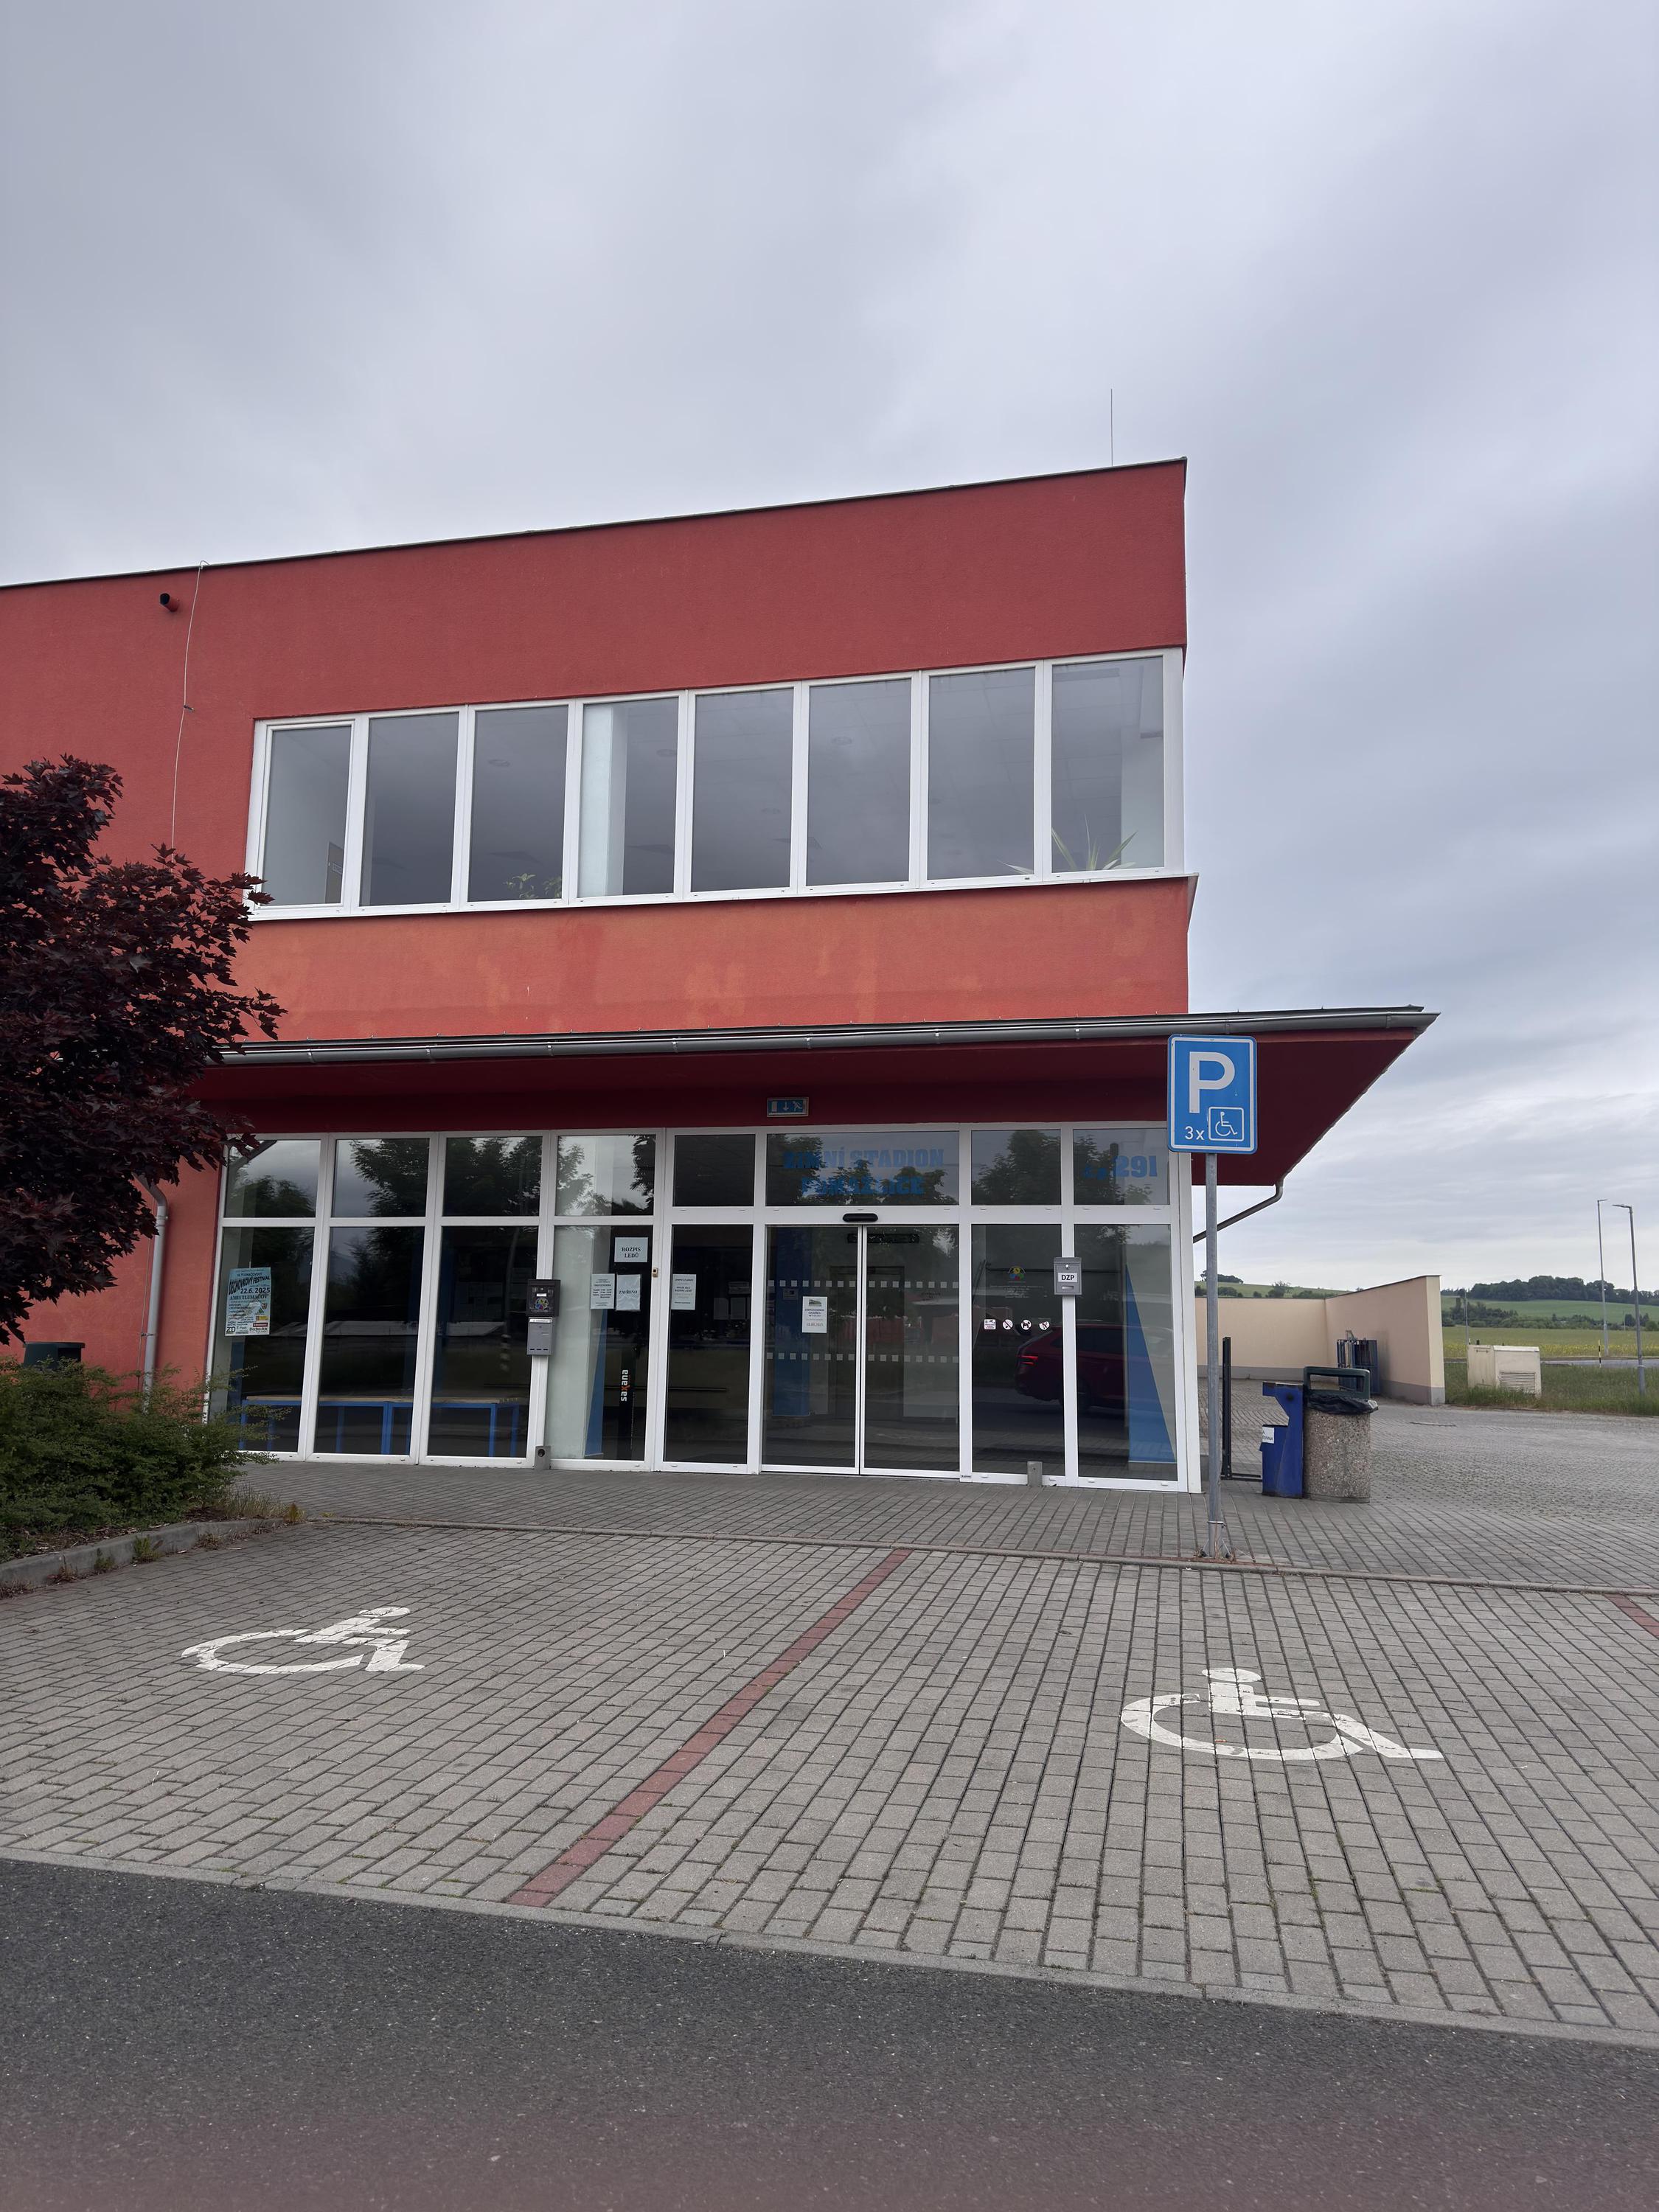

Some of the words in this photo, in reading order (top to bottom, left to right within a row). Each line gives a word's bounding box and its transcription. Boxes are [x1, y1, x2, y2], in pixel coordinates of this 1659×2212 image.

[1189, 1051, 1236, 1114] P
[1184, 1125, 1205, 1141] 3x
[849, 1149, 945, 1168] STADION
[253, 1276, 271, 1284] FESTIVAL
[620, 1369, 630, 1402] saxana
